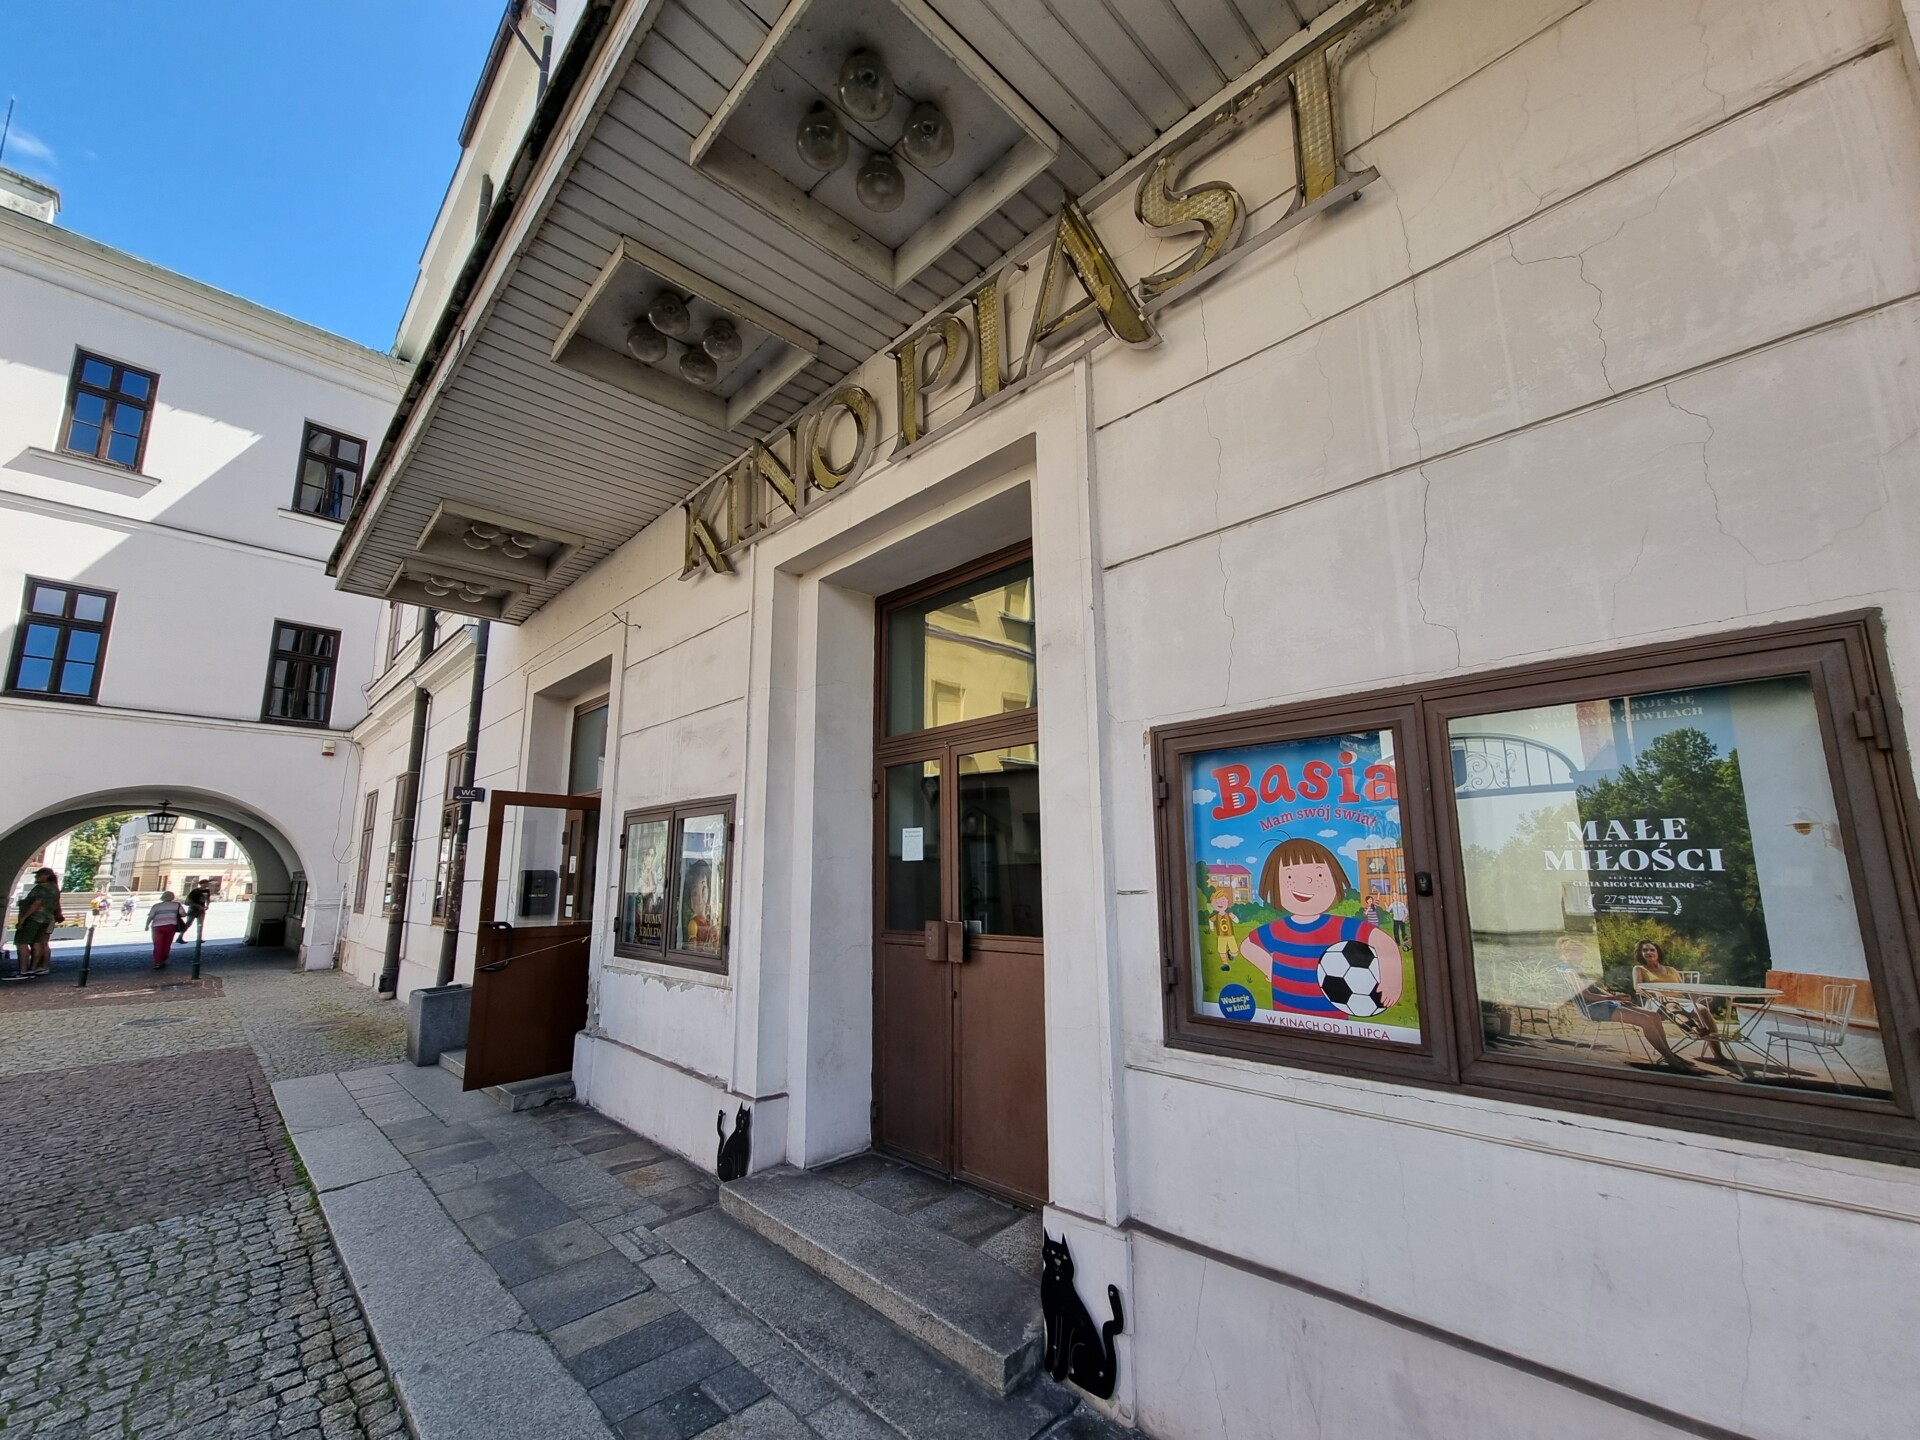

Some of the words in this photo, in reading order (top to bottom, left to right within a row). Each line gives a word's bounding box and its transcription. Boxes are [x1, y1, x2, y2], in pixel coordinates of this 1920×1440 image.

[679, 383, 880, 582] KINO
[887, 0, 1412, 465] PIAST
[1671, 695, 1696, 706] SIĘ
[1620, 706, 1704, 722] CHWILACH
[1211, 750, 1399, 820] Basia
[1258, 813, 1294, 832] Mam
[1297, 805, 1330, 821] swój
[1334, 806, 1378, 829] świat
[1566, 818, 1688, 841] MAŁE
[1542, 842, 1727, 872] MIŁOŚCI
[1572, 880, 1601, 888] CELIA
[1629, 881, 1695, 889] CLAVELLINO
[1603, 894, 1618, 904] 27
[639, 924, 661, 938] KRÓLEW
[1220, 918, 1229, 932] 6
[1220, 993, 1250, 1005] Wakacje
[1233, 1002, 1251, 1012] kinie
[1266, 1014, 1276, 1024] W
[1279, 1017, 1320, 1032] KINACH
[1323, 1022, 1341, 1034] OD
[1345, 1025, 1354, 1036] 11
[1358, 1027, 1391, 1040] LIPCA
